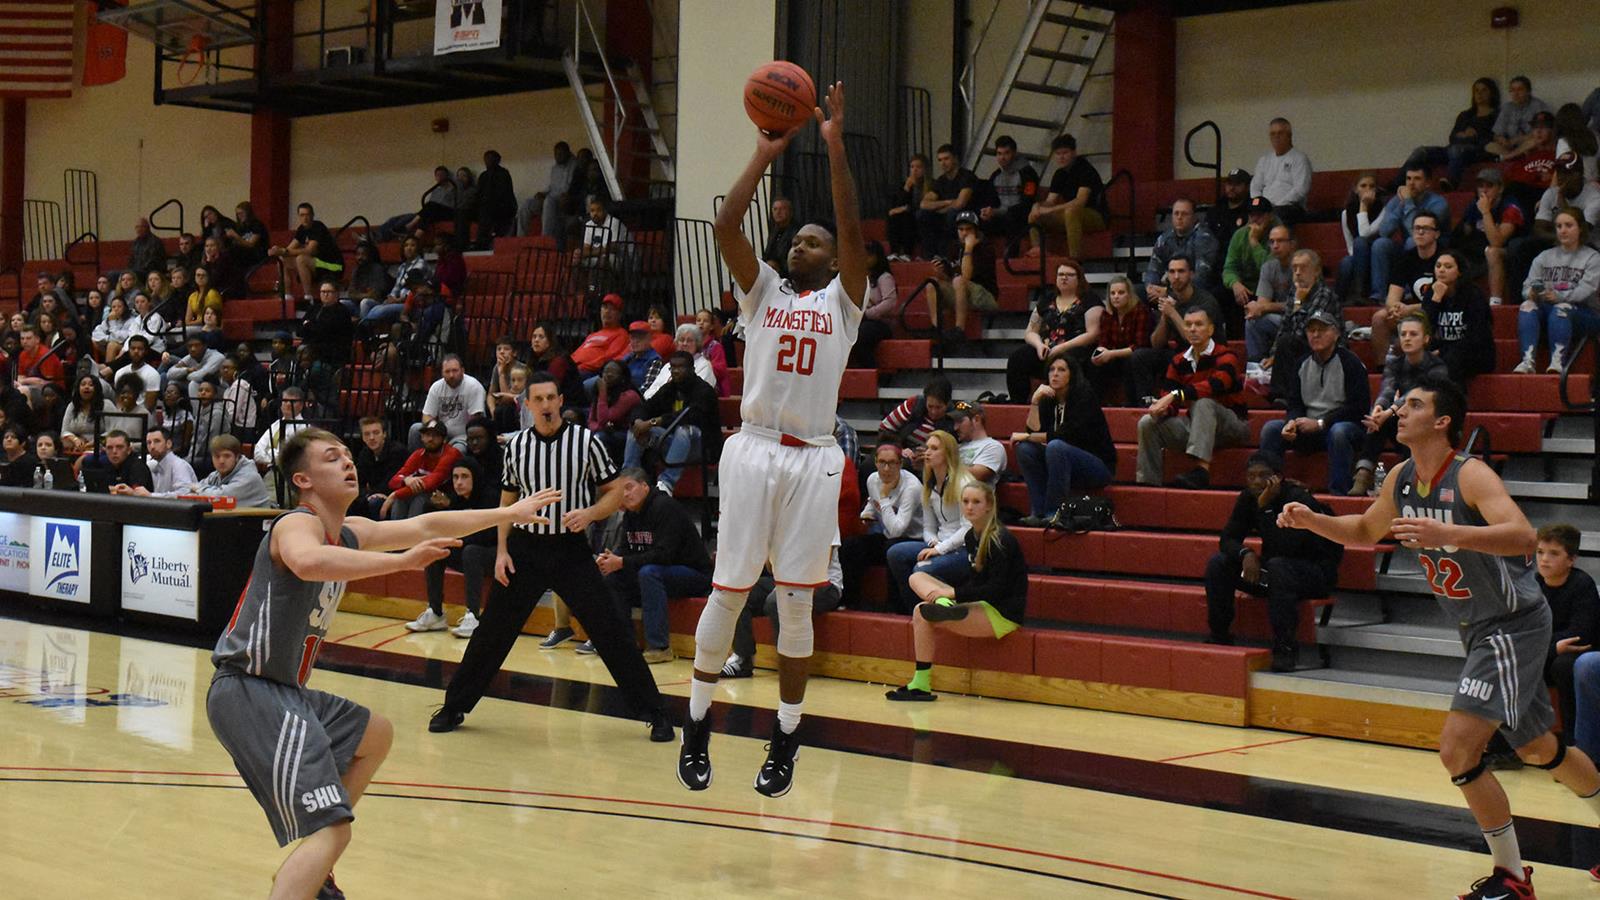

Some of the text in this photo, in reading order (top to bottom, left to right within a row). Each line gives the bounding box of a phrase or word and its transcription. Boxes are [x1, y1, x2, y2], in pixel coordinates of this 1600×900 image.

[762, 306, 833, 335] MANSFIELD
[776, 334, 817, 376] 20
[52, 552, 72, 568] ELITE
[151, 557, 190, 575] Liberty
[56, 582, 79, 596] THERAPY
[1418, 553, 1472, 599] 22
[1459, 676, 1494, 702] SHU
[301, 783, 341, 813] SHU
